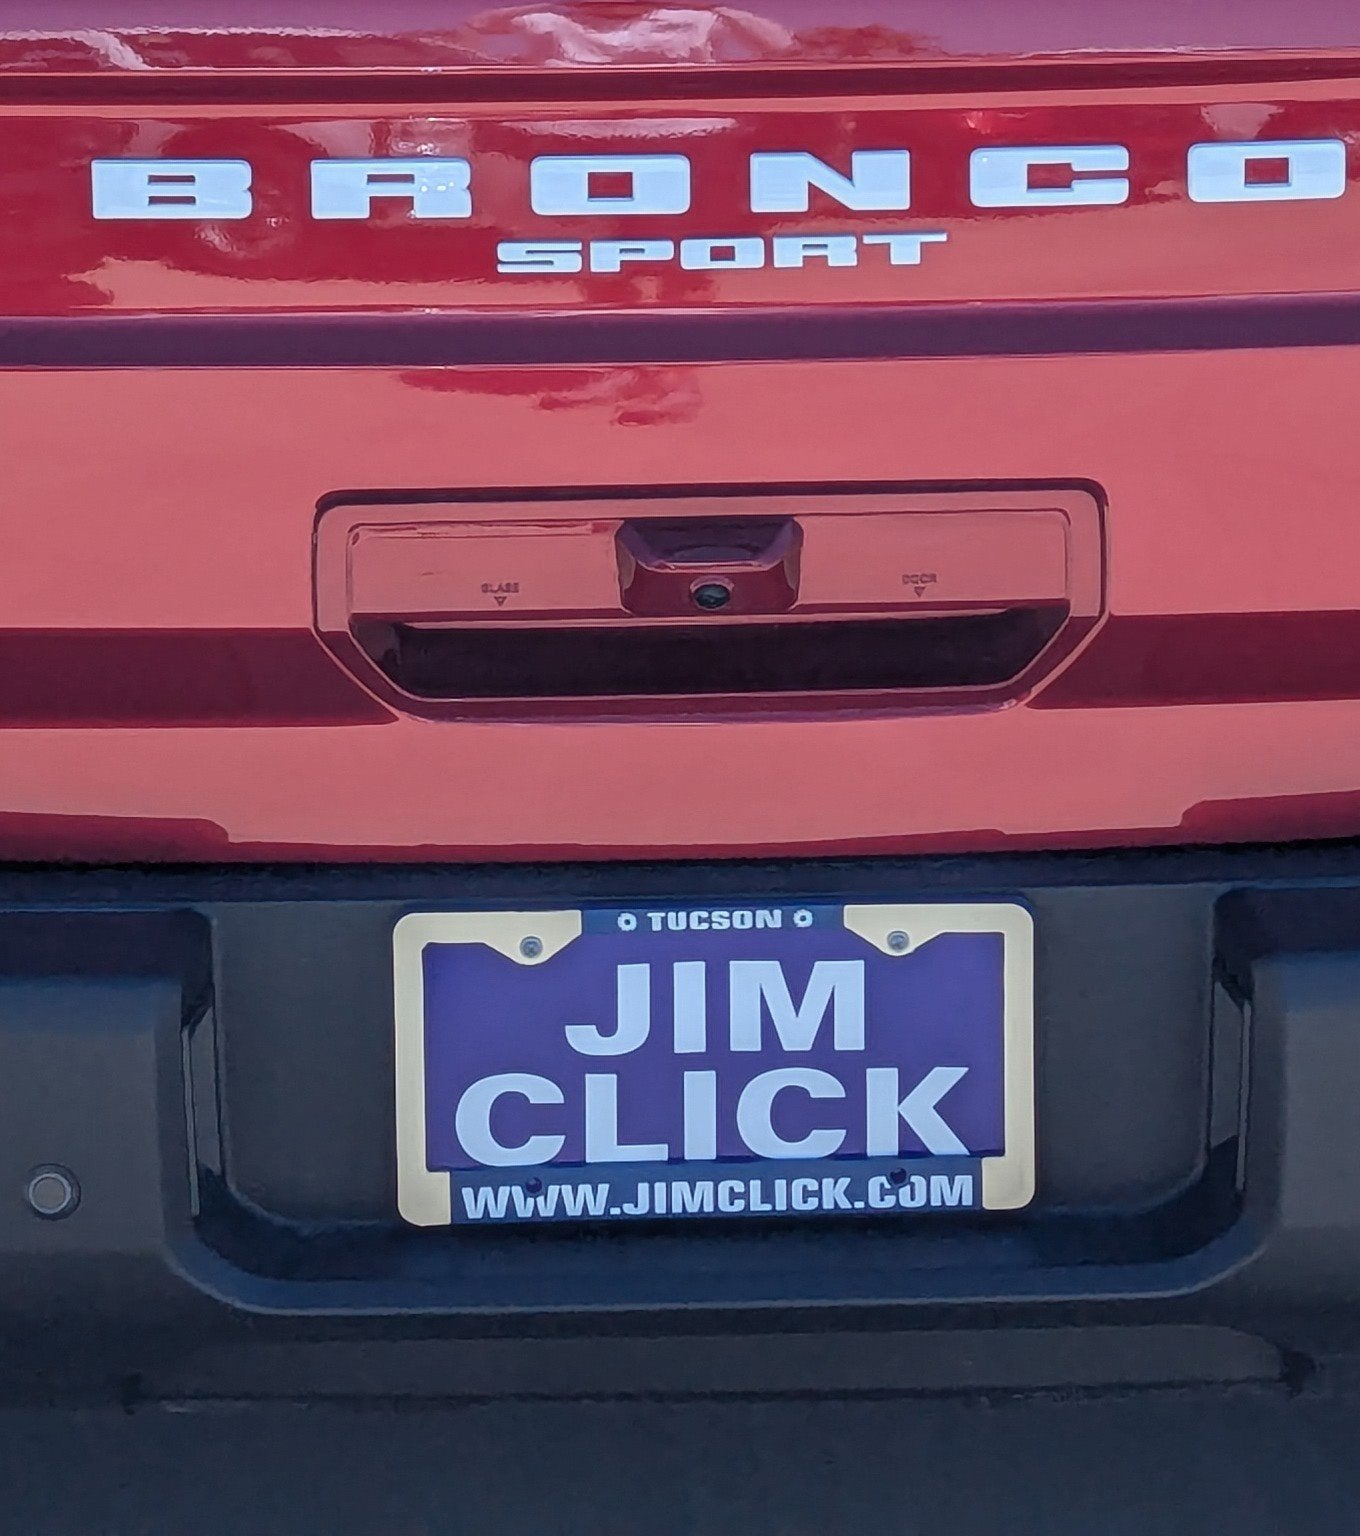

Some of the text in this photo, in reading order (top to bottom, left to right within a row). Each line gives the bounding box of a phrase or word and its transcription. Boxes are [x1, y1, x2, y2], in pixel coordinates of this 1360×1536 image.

[91, 140, 1346, 220] BRONCO
[497, 232, 947, 273] SPORT
[647, 909, 782, 931] TUCSON
[565, 959, 864, 1055] JIM
[455, 1066, 969, 1166] CLICK
[461, 1175, 973, 1219] WWW.JIMCLICK.COM
